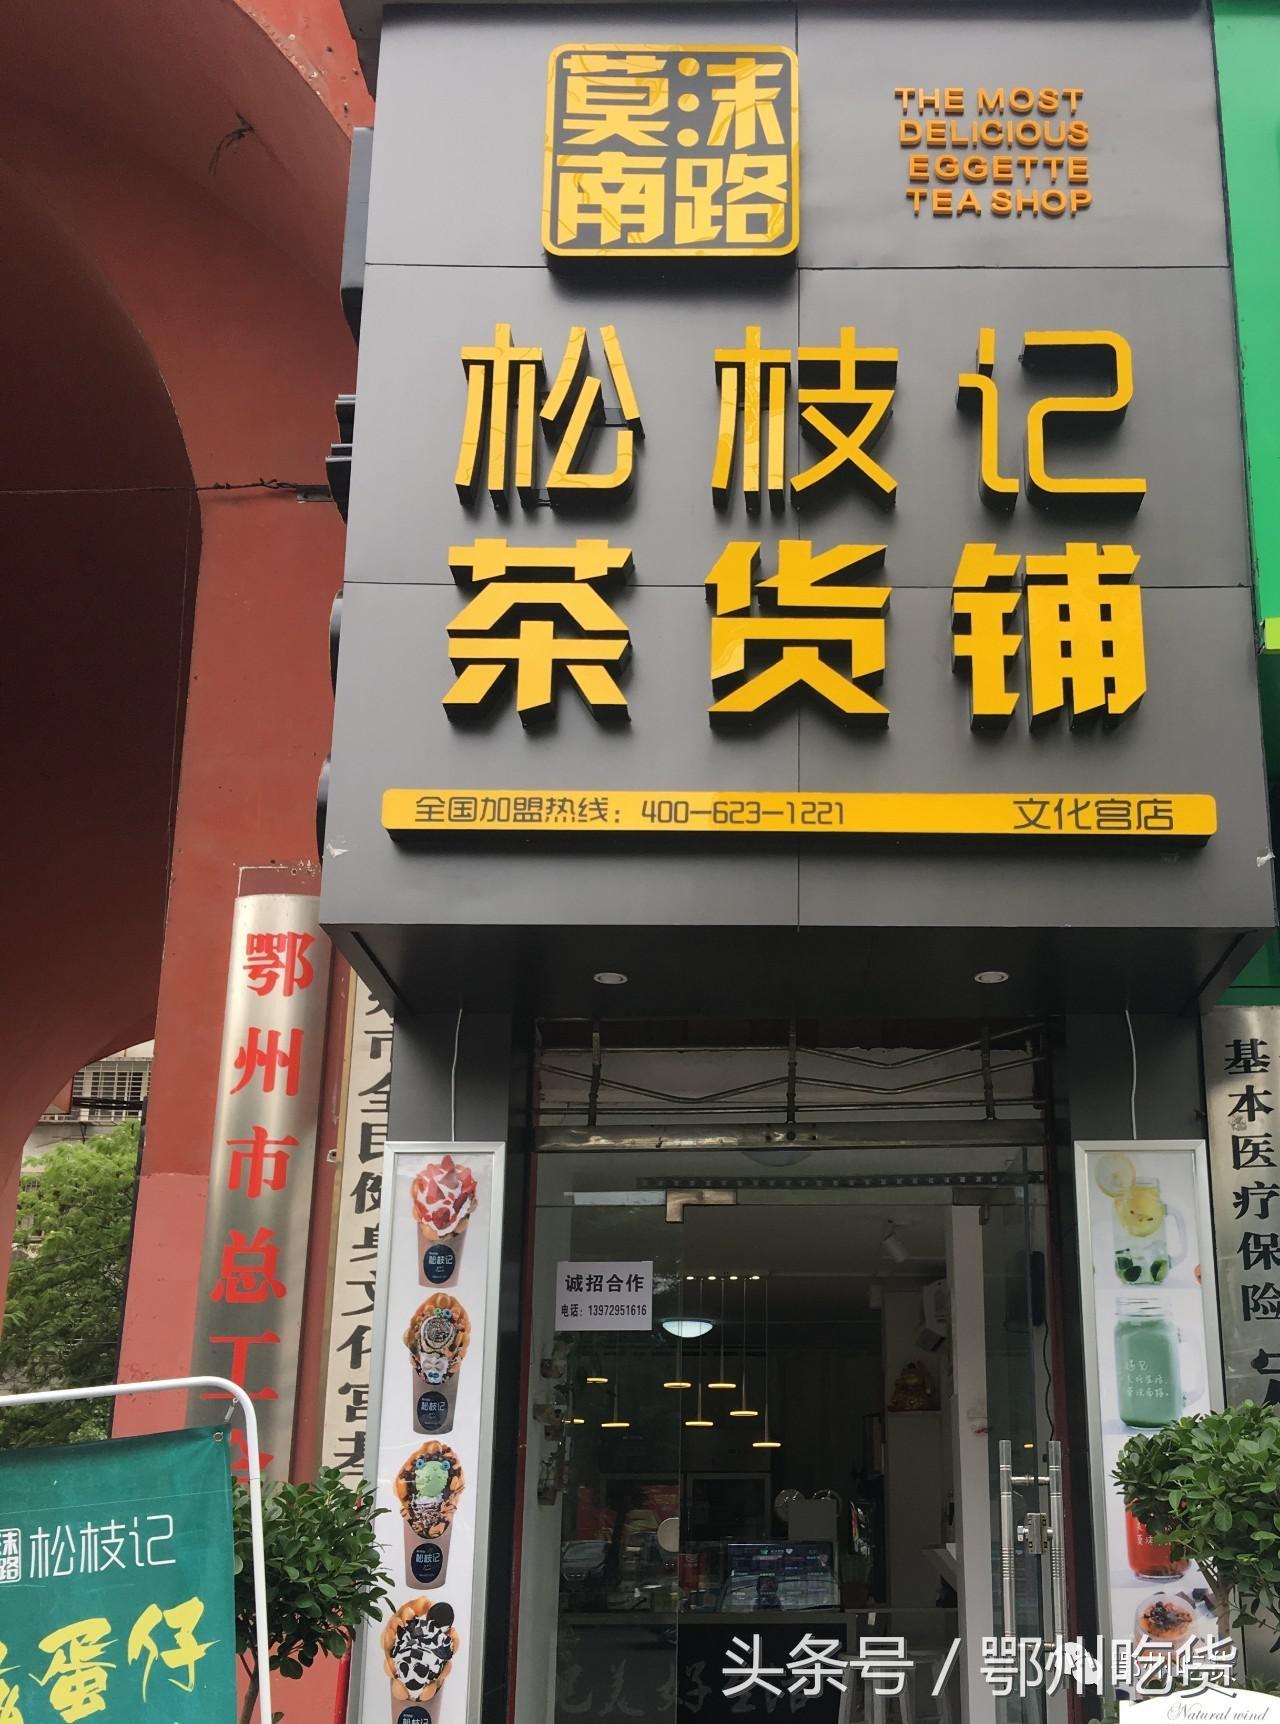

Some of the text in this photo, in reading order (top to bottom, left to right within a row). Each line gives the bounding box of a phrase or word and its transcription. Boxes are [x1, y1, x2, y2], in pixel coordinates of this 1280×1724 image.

[895, 87, 1085, 114] THE MOST
[899, 119, 1089, 147] DELICIOUS
[908, 154, 1089, 183] EGGETTE
[906, 187, 1093, 216] TEA SHOP
[454, 322, 1147, 505] 松枝记
[442, 538, 1147, 722] 茶货铺
[641, 799, 846, 825] 400-623-1221
[1013, 797, 1174, 831] 文化宫店
[564, 1273, 645, 1293] 诚招合作
[587, 1304, 647, 1316] 13972951616
[29, 1514, 177, 1579] 松枝记
[0, 1596, 221, 1724] 蛋仔
